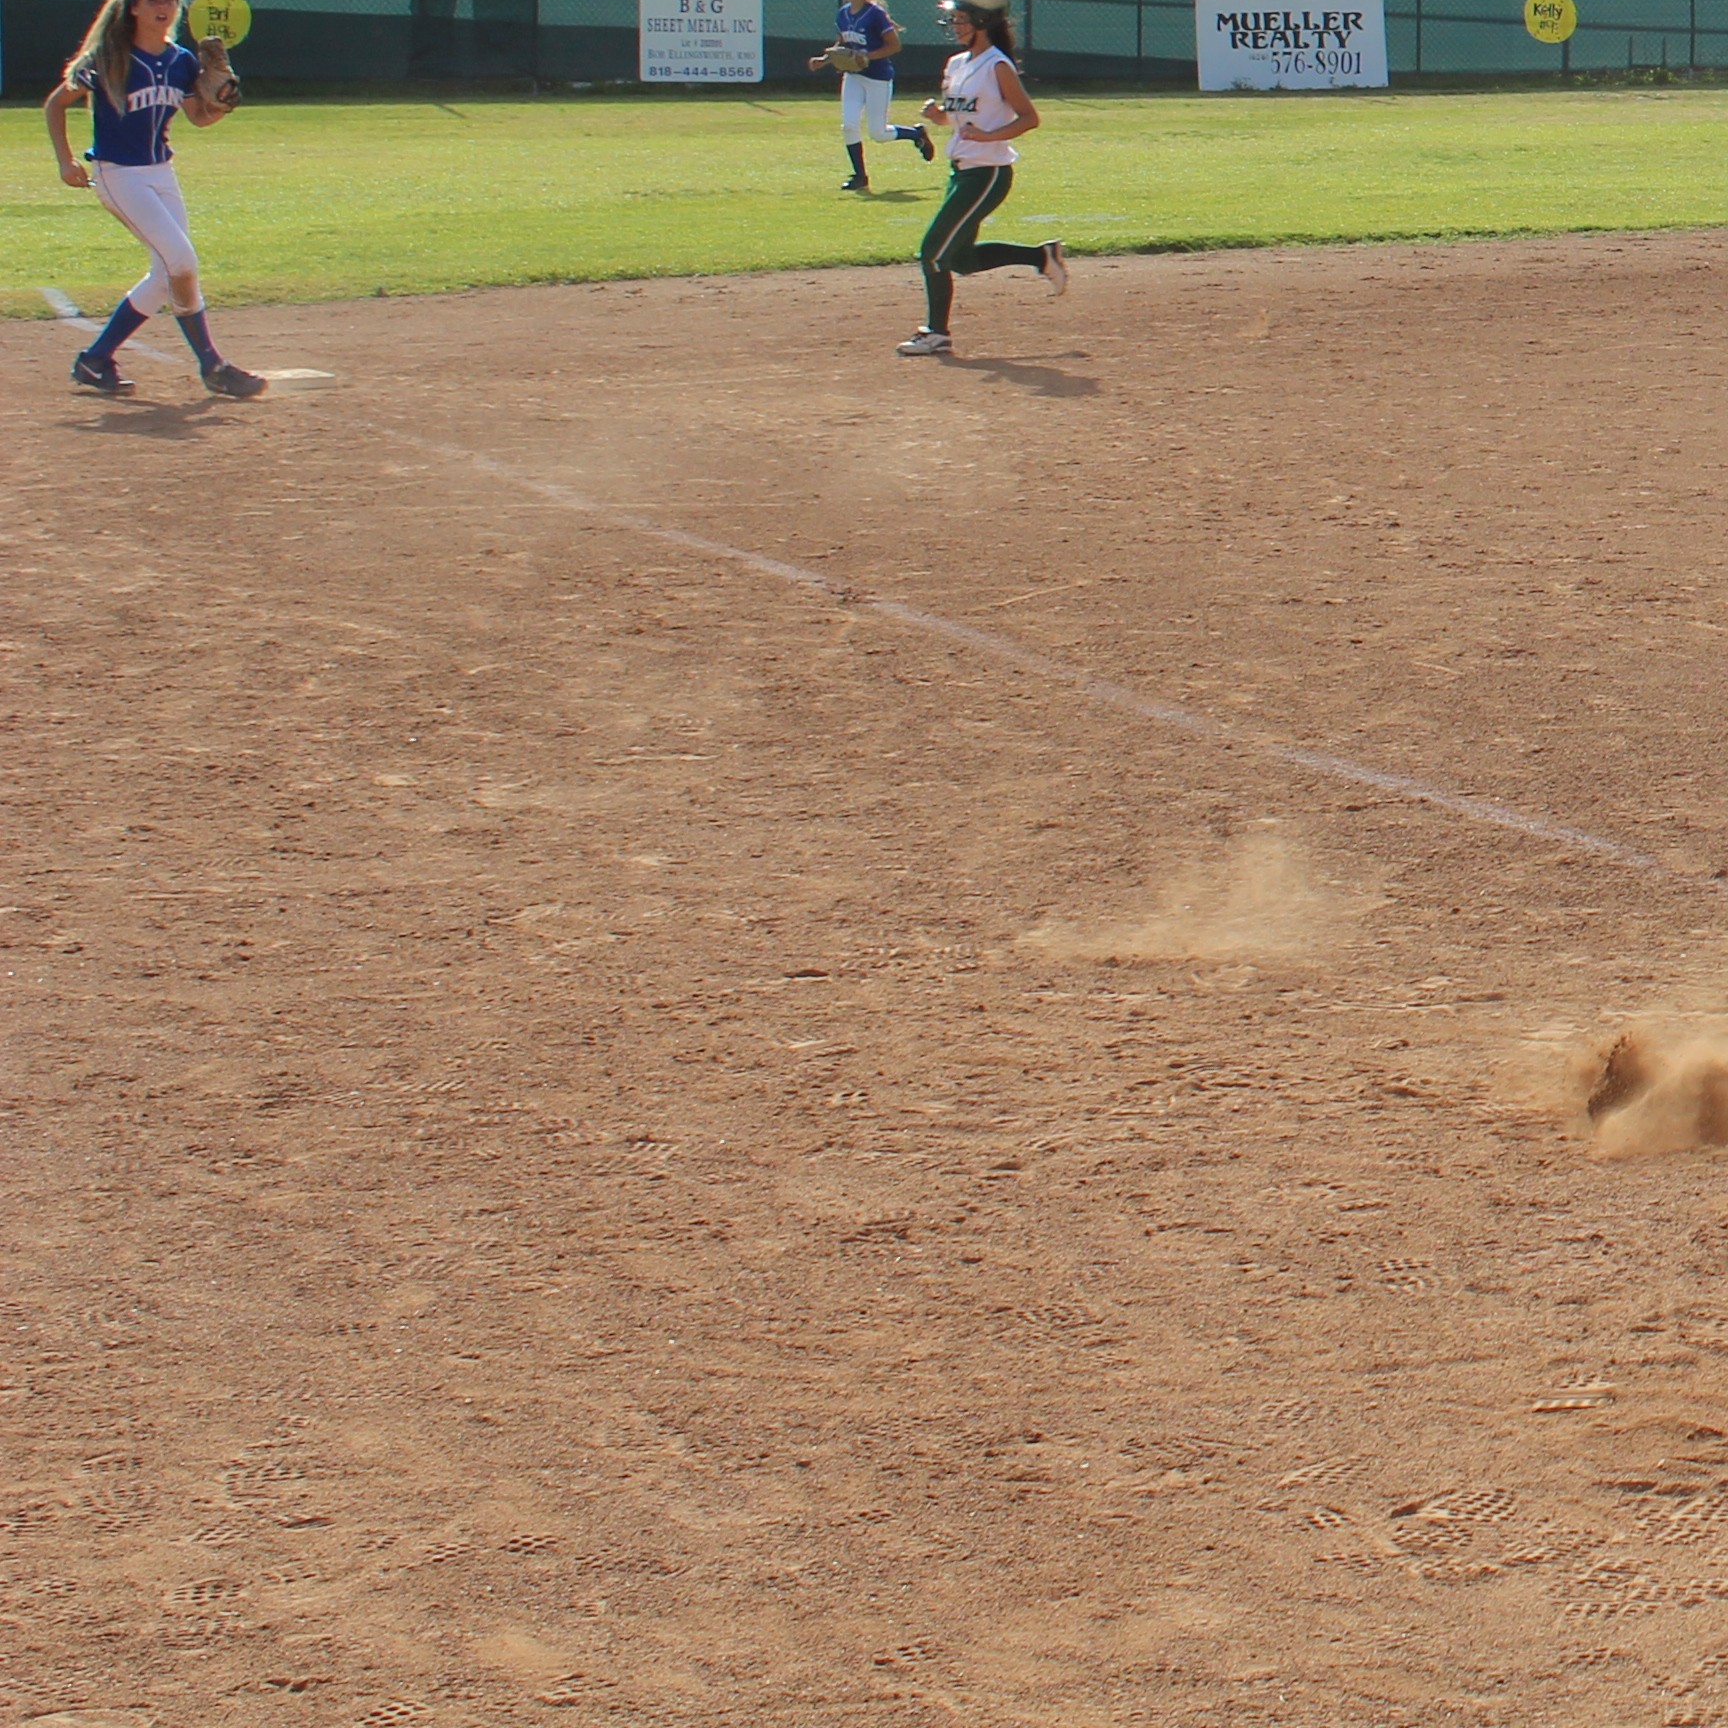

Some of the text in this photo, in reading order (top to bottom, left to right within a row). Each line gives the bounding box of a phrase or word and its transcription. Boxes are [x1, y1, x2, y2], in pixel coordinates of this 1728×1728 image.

[696, 0, 706, 13] &
[1533, 3, 1563, 21] Kelly
[647, 18, 684, 32] SHEET
[734, 19, 757, 33] INC.
[1217, 11, 1364, 31] MUELLER
[1229, 30, 1352, 49] REALTY
[649, 66, 754, 77] 818-444-8566
[1271, 51, 1361, 74] 576-8901
